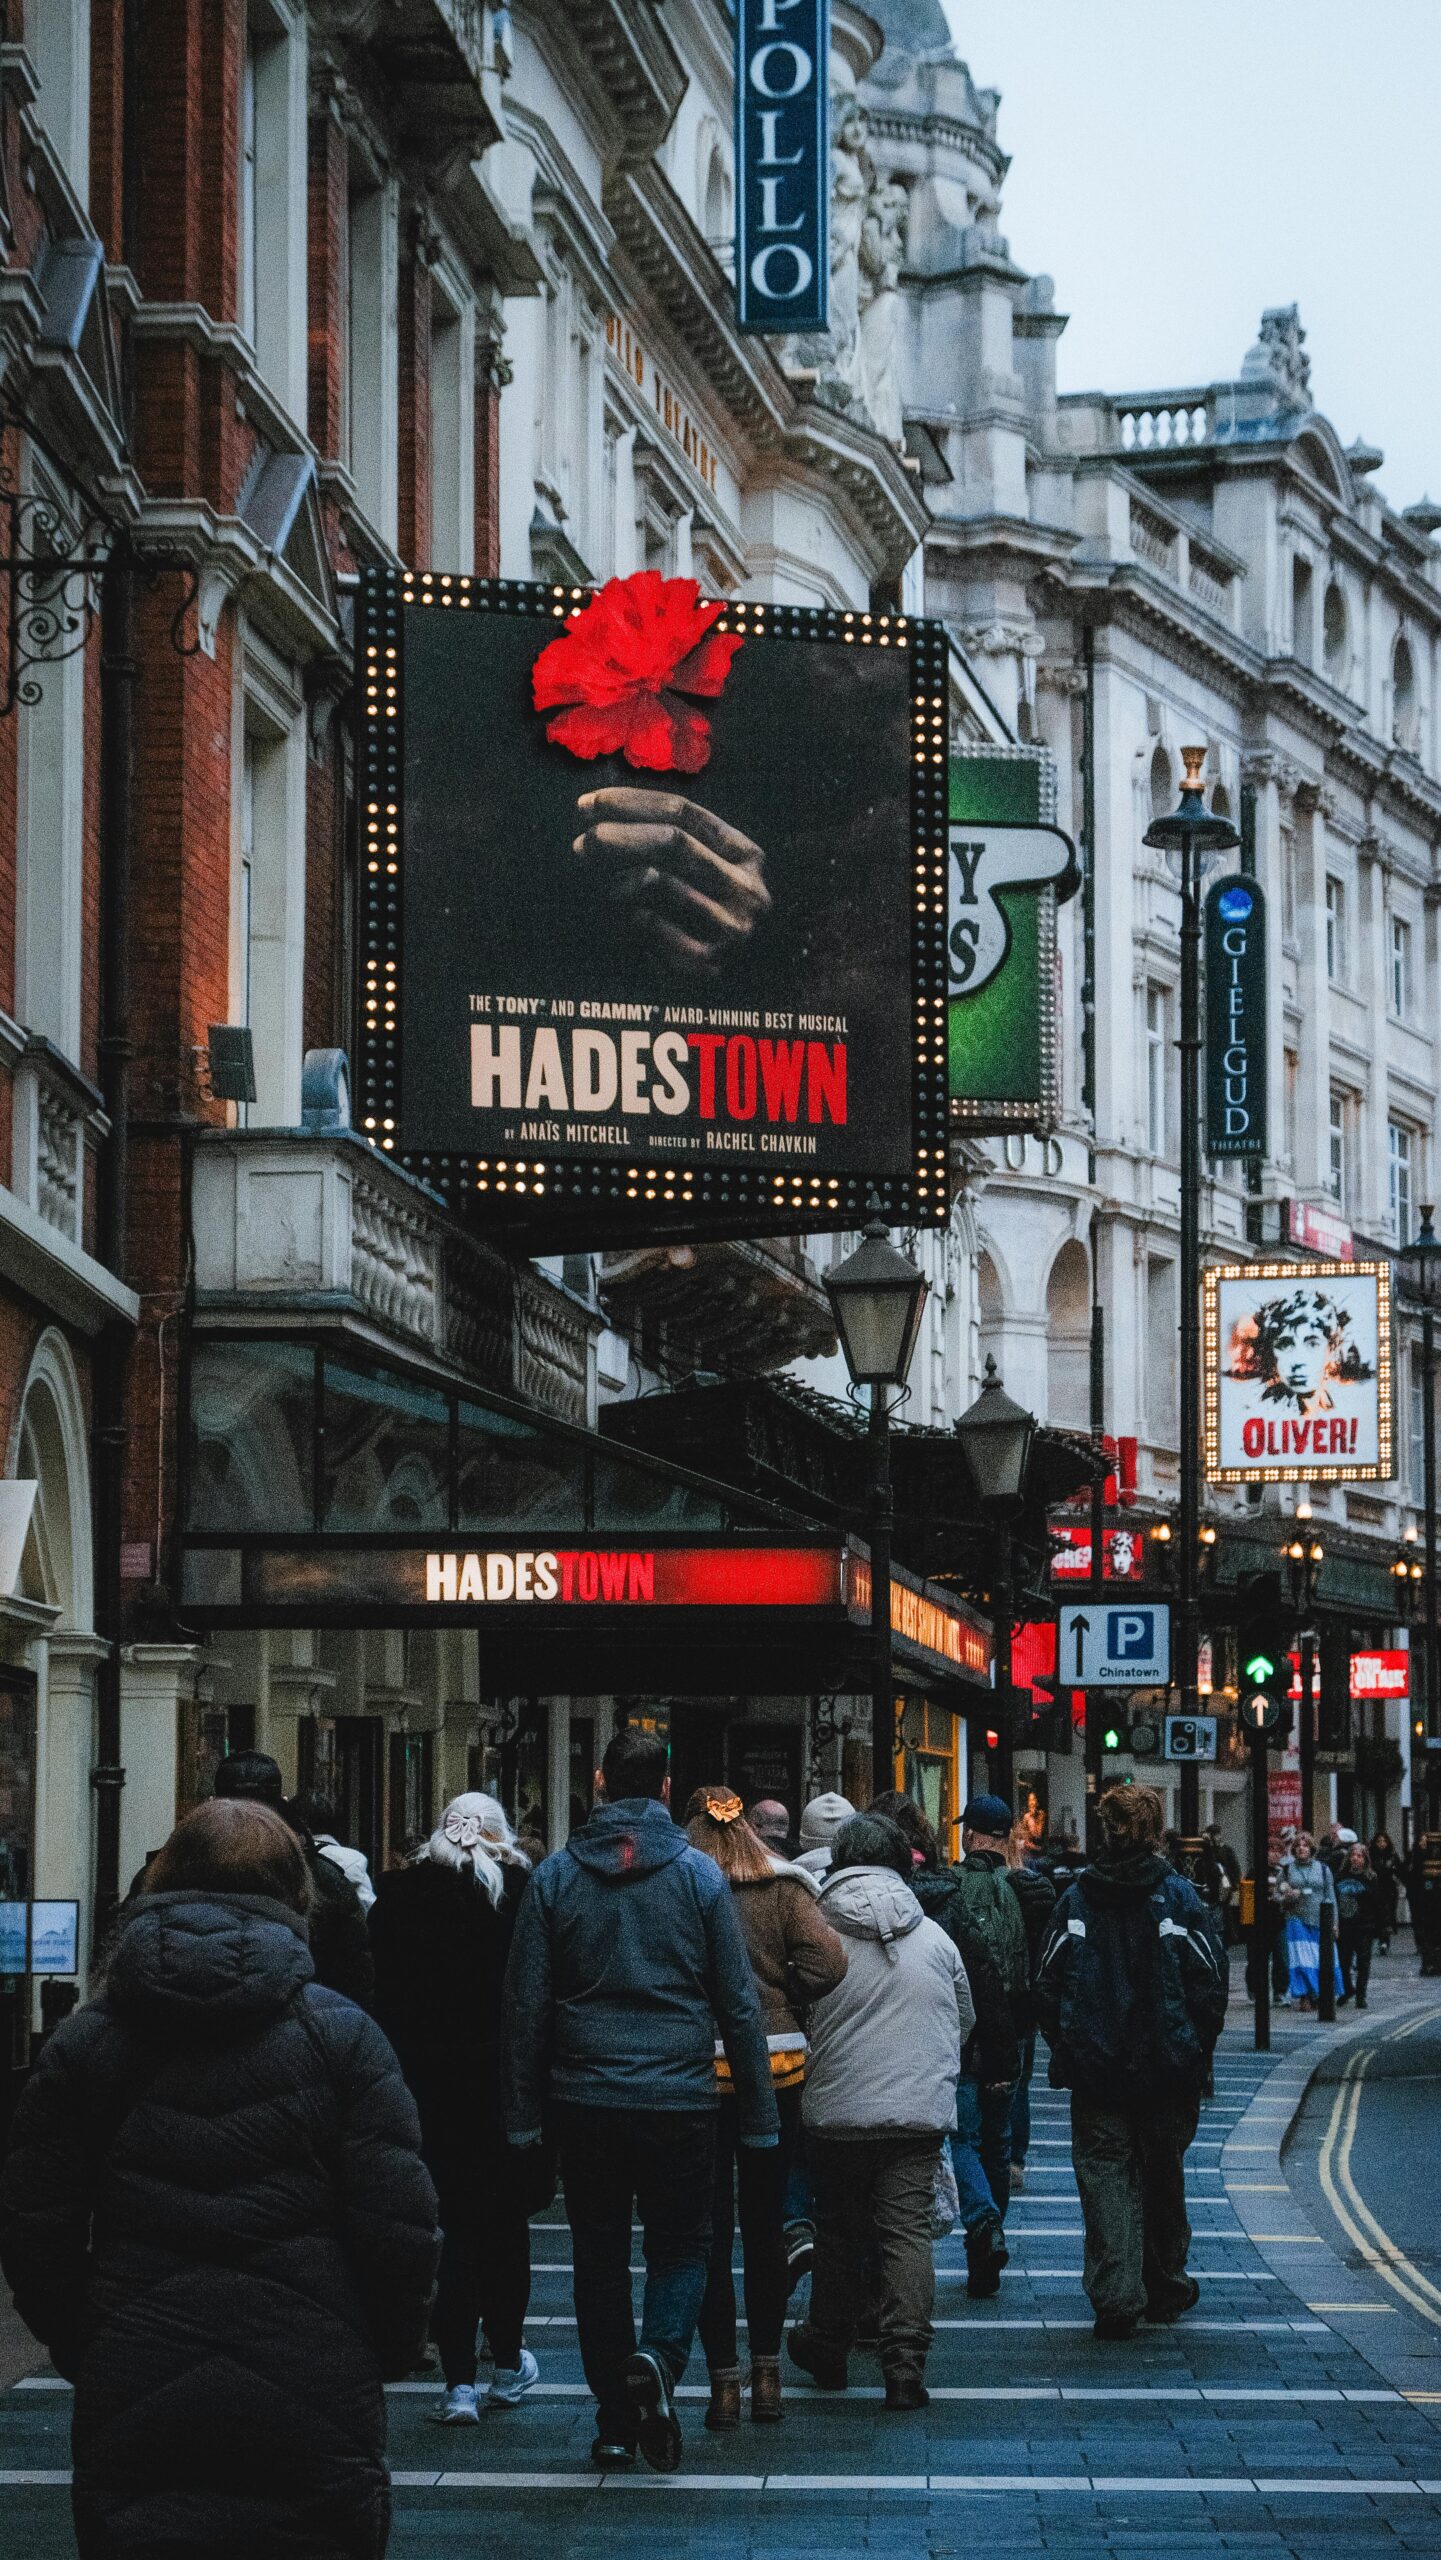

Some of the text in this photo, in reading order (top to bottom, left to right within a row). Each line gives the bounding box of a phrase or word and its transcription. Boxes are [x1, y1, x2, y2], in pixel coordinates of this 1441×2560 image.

[469, 994, 491, 1012] THE
[550, 1000, 575, 1018] AND
[664, 1007, 760, 1028] AWARD-WINNING
[764, 1011, 794, 1030] BEST
[799, 1014, 849, 1033] MUSICAL
[1222, 928, 1250, 1135] GIELGUD
[469, 1023, 848, 1126] HADESTOWN
[504, 1119, 817, 1154] BY ANAÏS MITCHELL DIRECTED BY RACHEL CHAVKIN
[1243, 1416, 1359, 1459] OLIVER!
[425, 1551, 654, 1602] HADESTOWN
[1117, 1615, 1145, 1656] P
[1099, 1666, 1160, 1678] Chinatown
